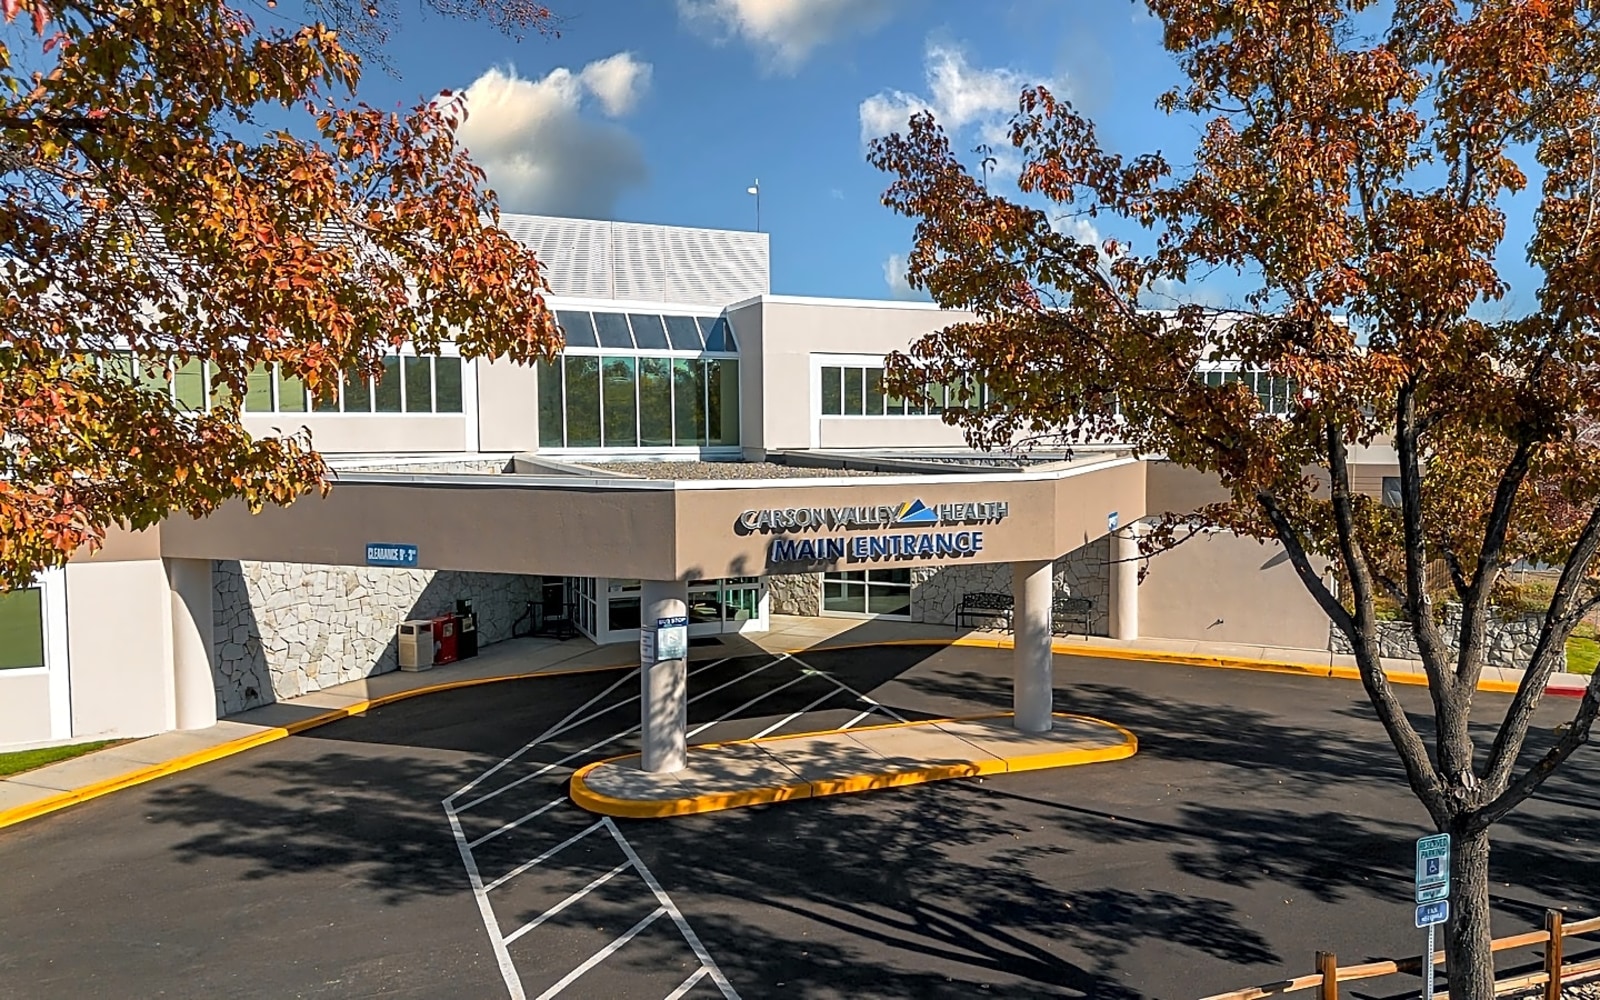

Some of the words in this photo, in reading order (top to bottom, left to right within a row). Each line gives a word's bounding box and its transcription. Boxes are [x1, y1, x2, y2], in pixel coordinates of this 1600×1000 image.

[740, 508, 827, 530] CARSON
[829, 505, 899, 525] VALLEY
[940, 502, 1009, 521] HEALTH
[368, 547, 399, 560] CLEARANCE
[771, 538, 845, 562] MAIN
[853, 532, 983, 558] ENTRANCE
[1420, 849, 1446, 859] PARKING
